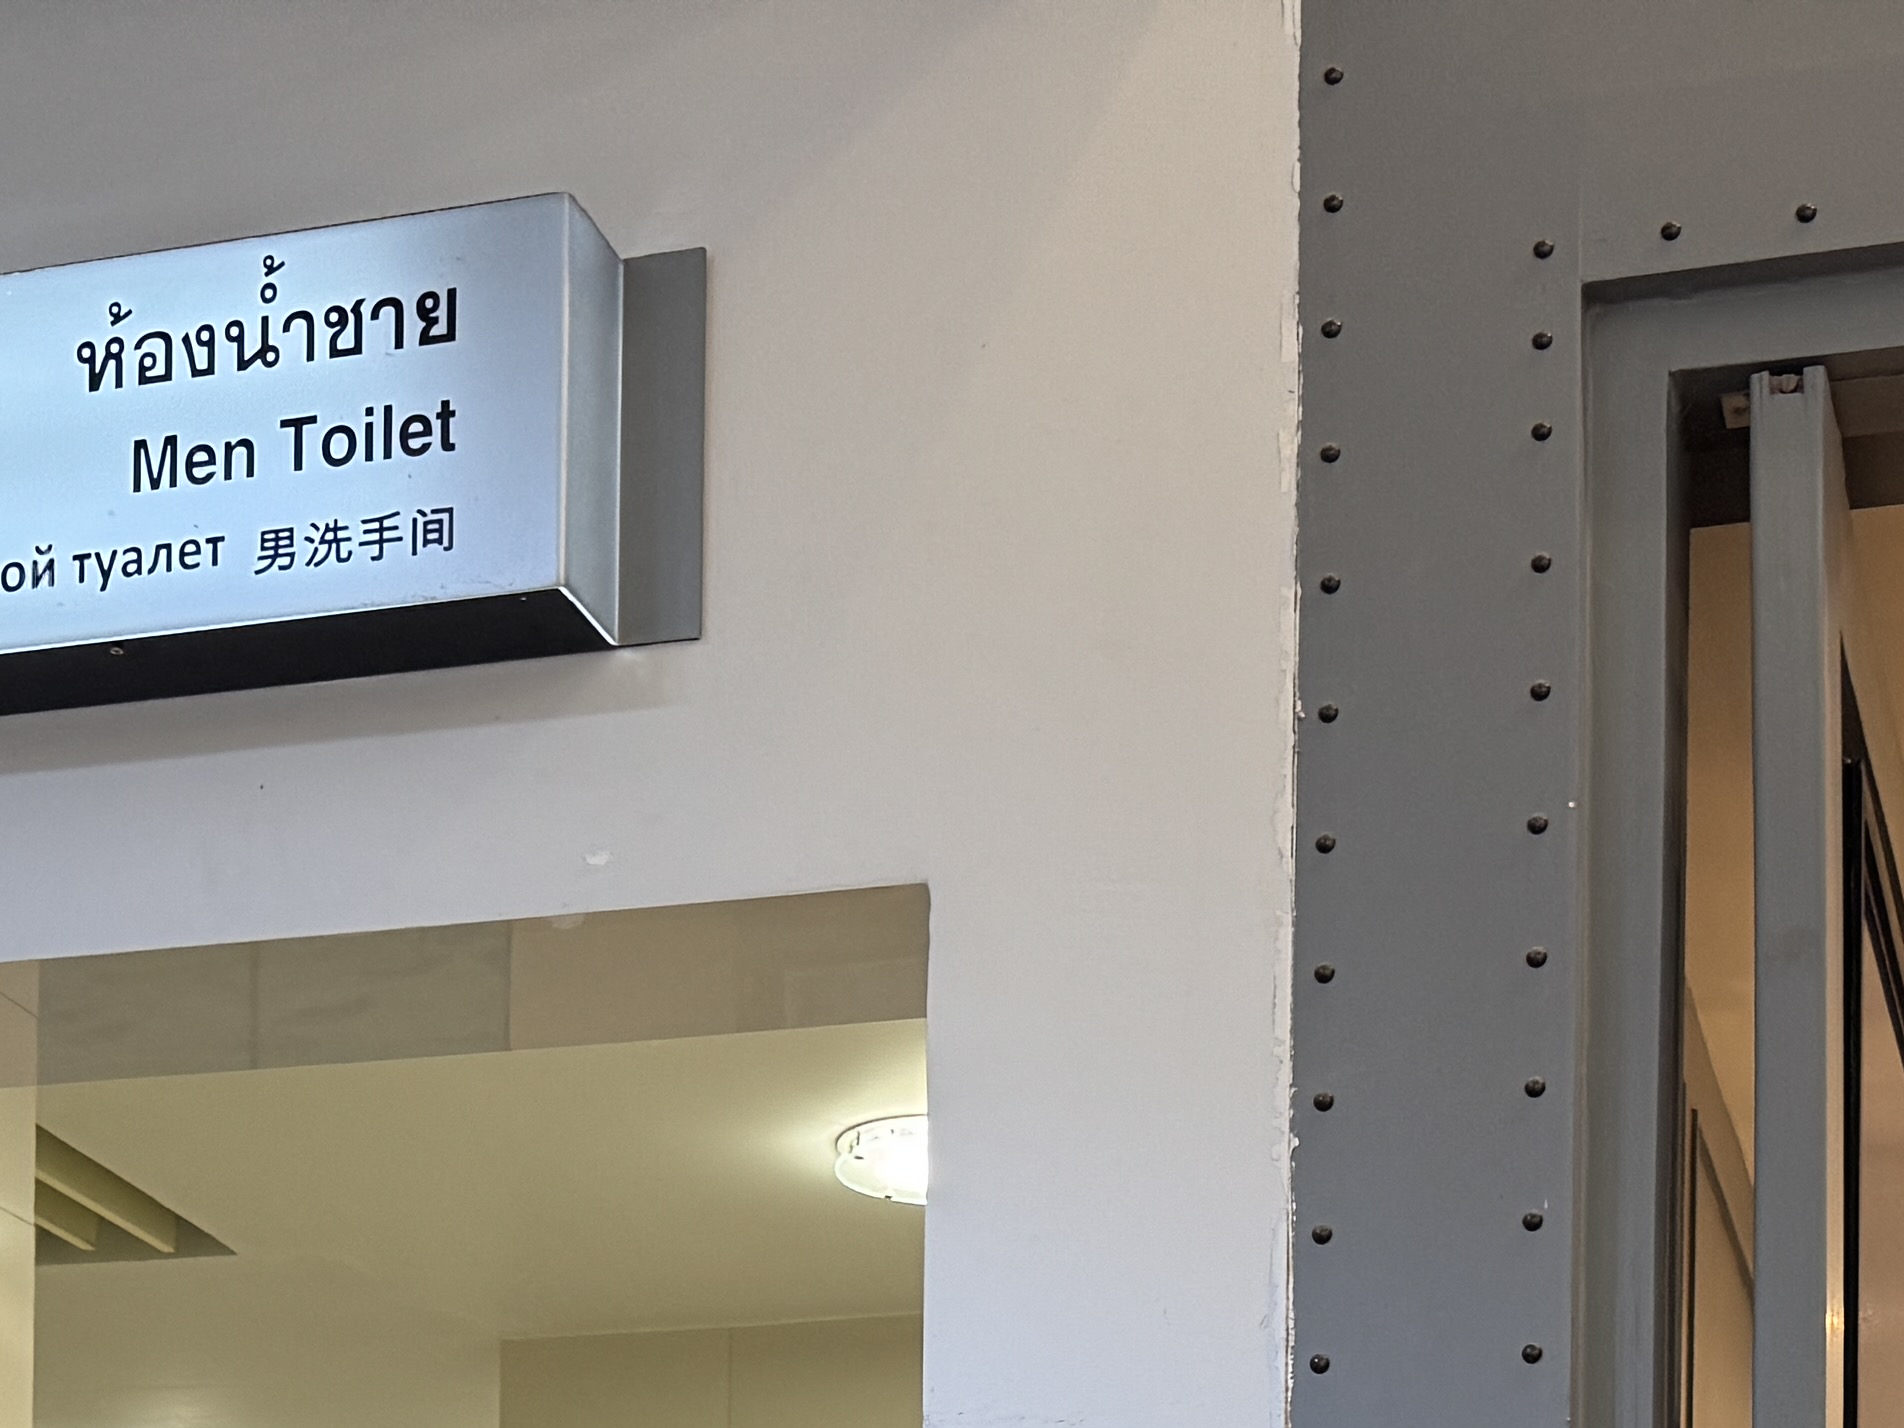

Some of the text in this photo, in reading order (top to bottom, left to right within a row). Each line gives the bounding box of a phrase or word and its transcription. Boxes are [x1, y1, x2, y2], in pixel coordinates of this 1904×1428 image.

[76, 254, 459, 393] ห้องน้ำชาย
[132, 399, 457, 494] Men Toilet
[72, 532, 226, 595] туалет
[253, 506, 456, 576] 男洗手间
